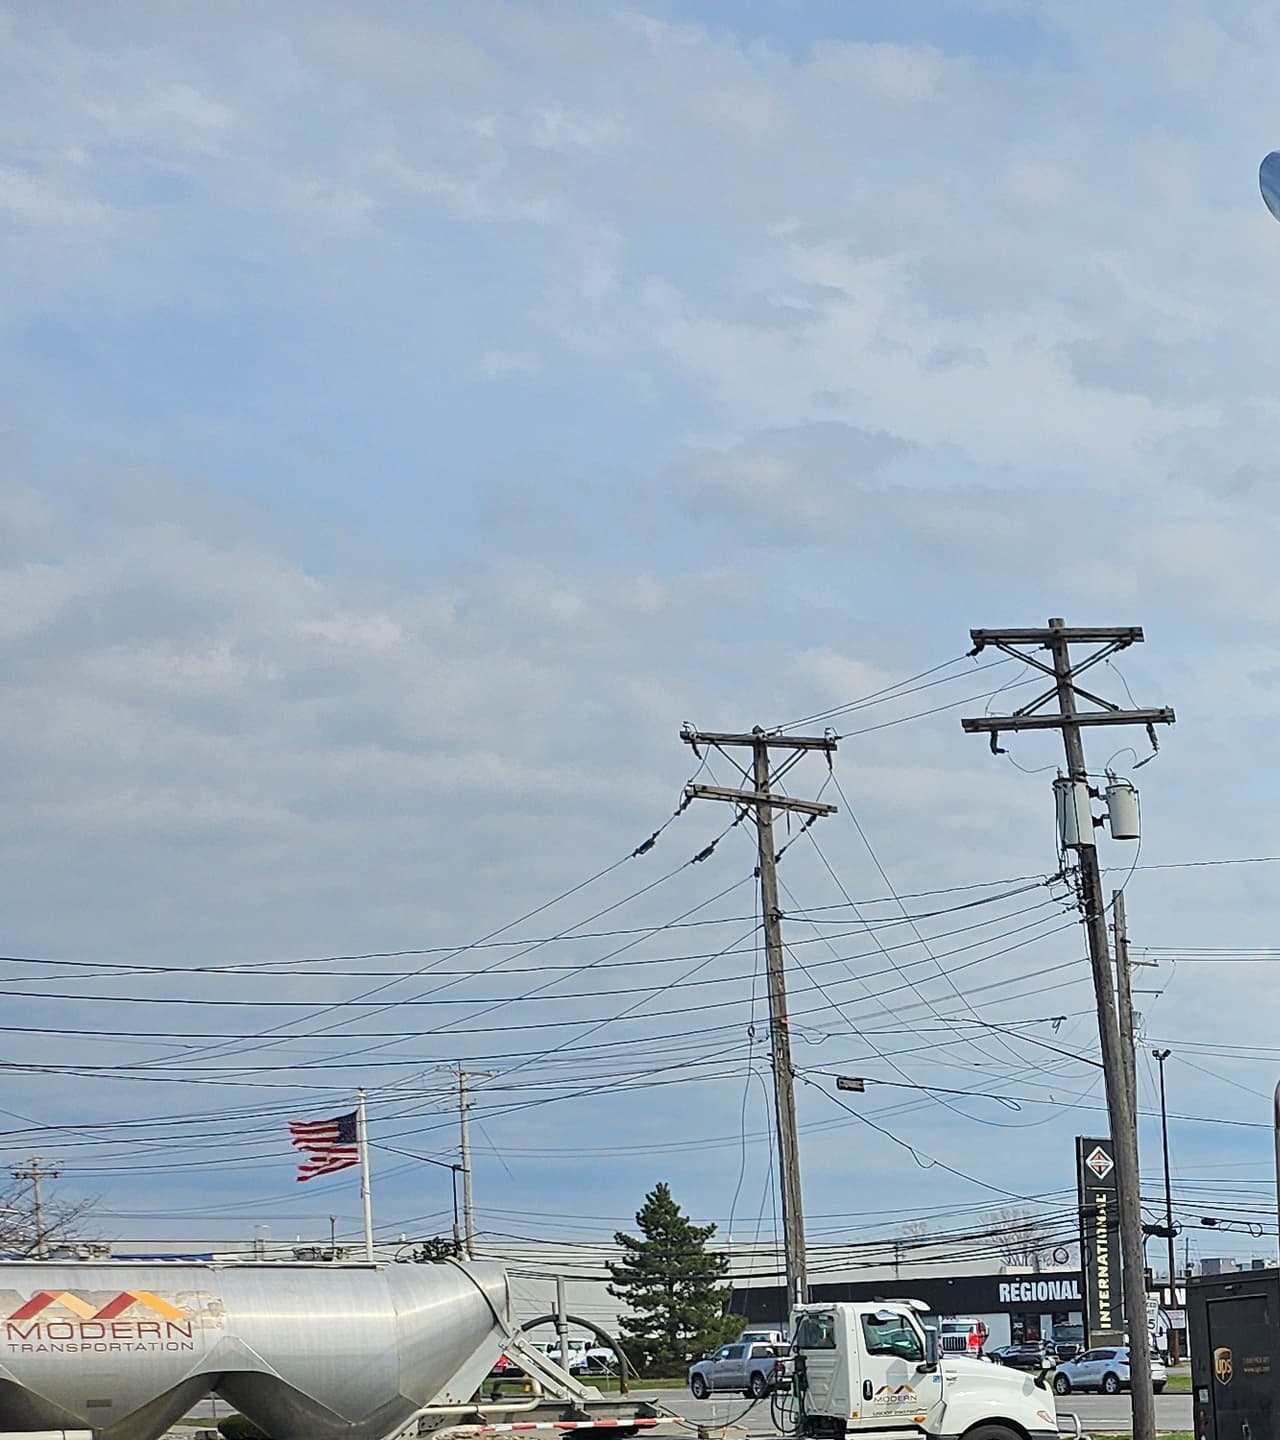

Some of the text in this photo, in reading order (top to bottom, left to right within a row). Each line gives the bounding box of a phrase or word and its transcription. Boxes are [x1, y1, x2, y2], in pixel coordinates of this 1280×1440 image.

[1000, 1280, 1082, 1303] REGIONAL
[6, 1320, 193, 1341] MODERN
[7, 1341, 195, 1353] TRANSPORTATION
[873, 1394, 918, 1403] MODERN
